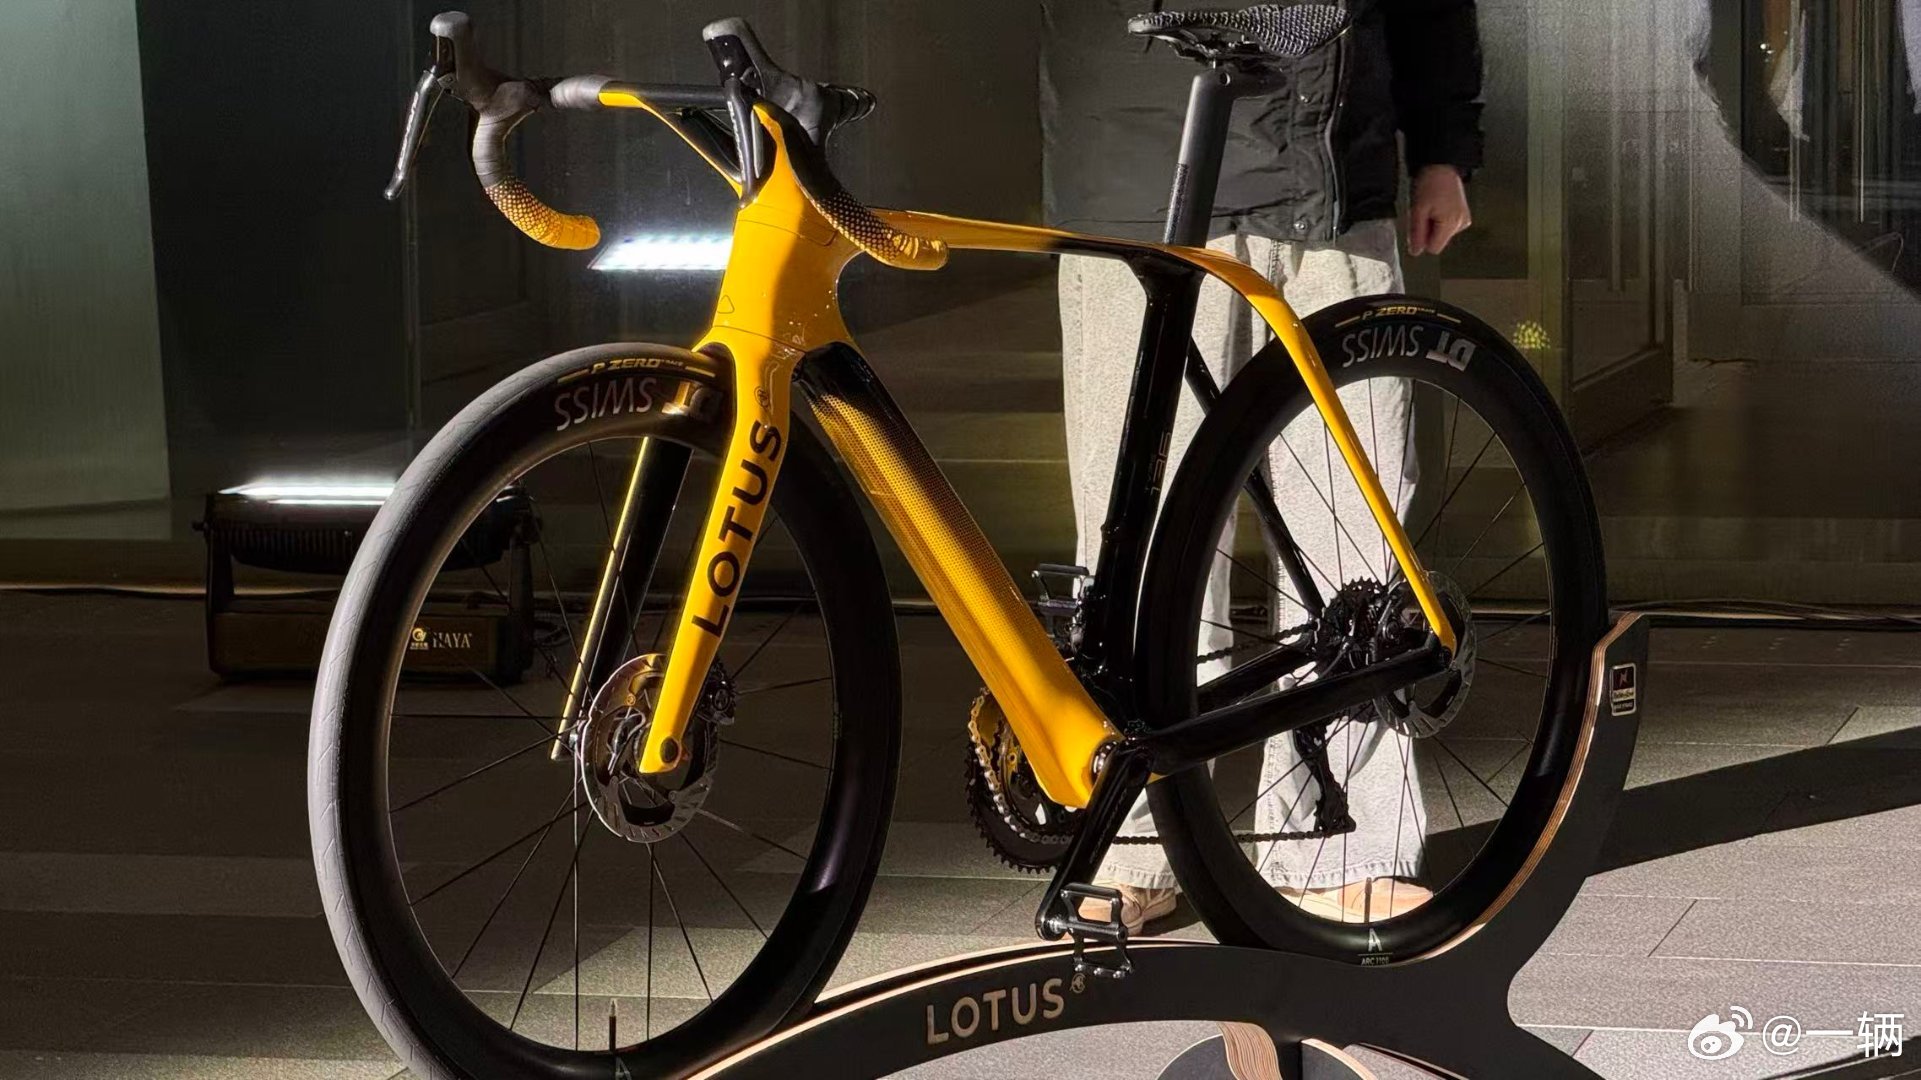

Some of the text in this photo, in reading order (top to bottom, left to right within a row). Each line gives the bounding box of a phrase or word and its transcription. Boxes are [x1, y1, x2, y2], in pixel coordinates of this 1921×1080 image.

[1362, 311, 1373, 320] P
[1375, 306, 1417, 317] ZERO
[591, 362, 606, 374] P
[608, 358, 661, 371] ZERO
[1342, 325, 1477, 372] DT SWISS
[554, 377, 657, 431] SWISS
[691, 420, 782, 638] LOTUS
[927, 978, 1064, 1045] LOTUS
